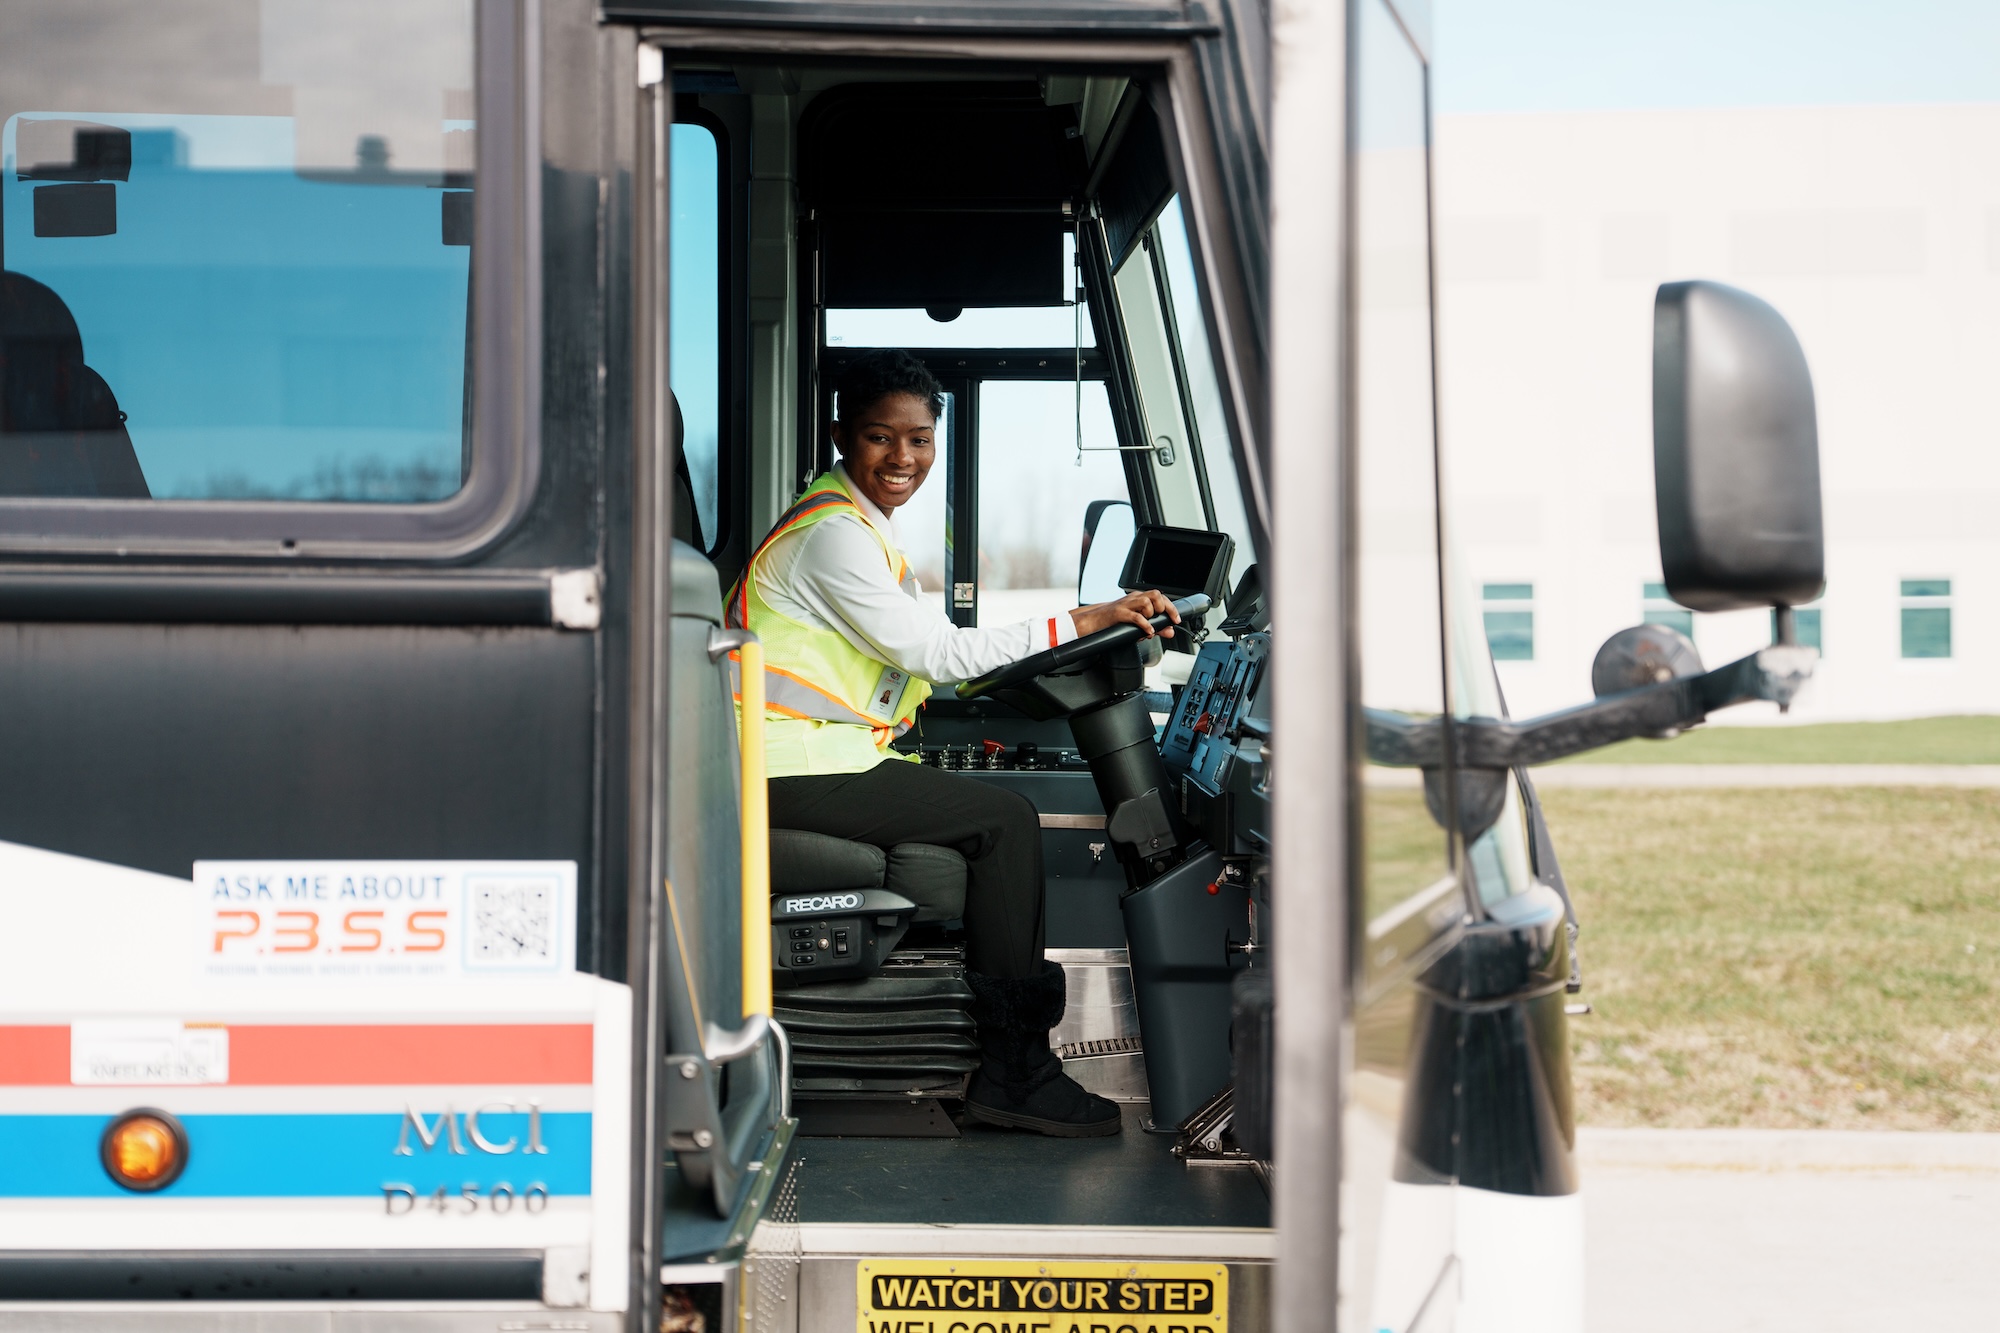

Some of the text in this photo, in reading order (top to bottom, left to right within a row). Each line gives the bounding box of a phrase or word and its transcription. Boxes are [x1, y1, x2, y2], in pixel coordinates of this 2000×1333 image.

[213, 875, 446, 900] ASK ME ABOUT
[786, 894, 858, 913] RECARO
[392, 1097, 549, 1156] MCI
[380, 1180, 549, 1216] D4500
[877, 1278, 1210, 1311] WATCH YOUR STEP
